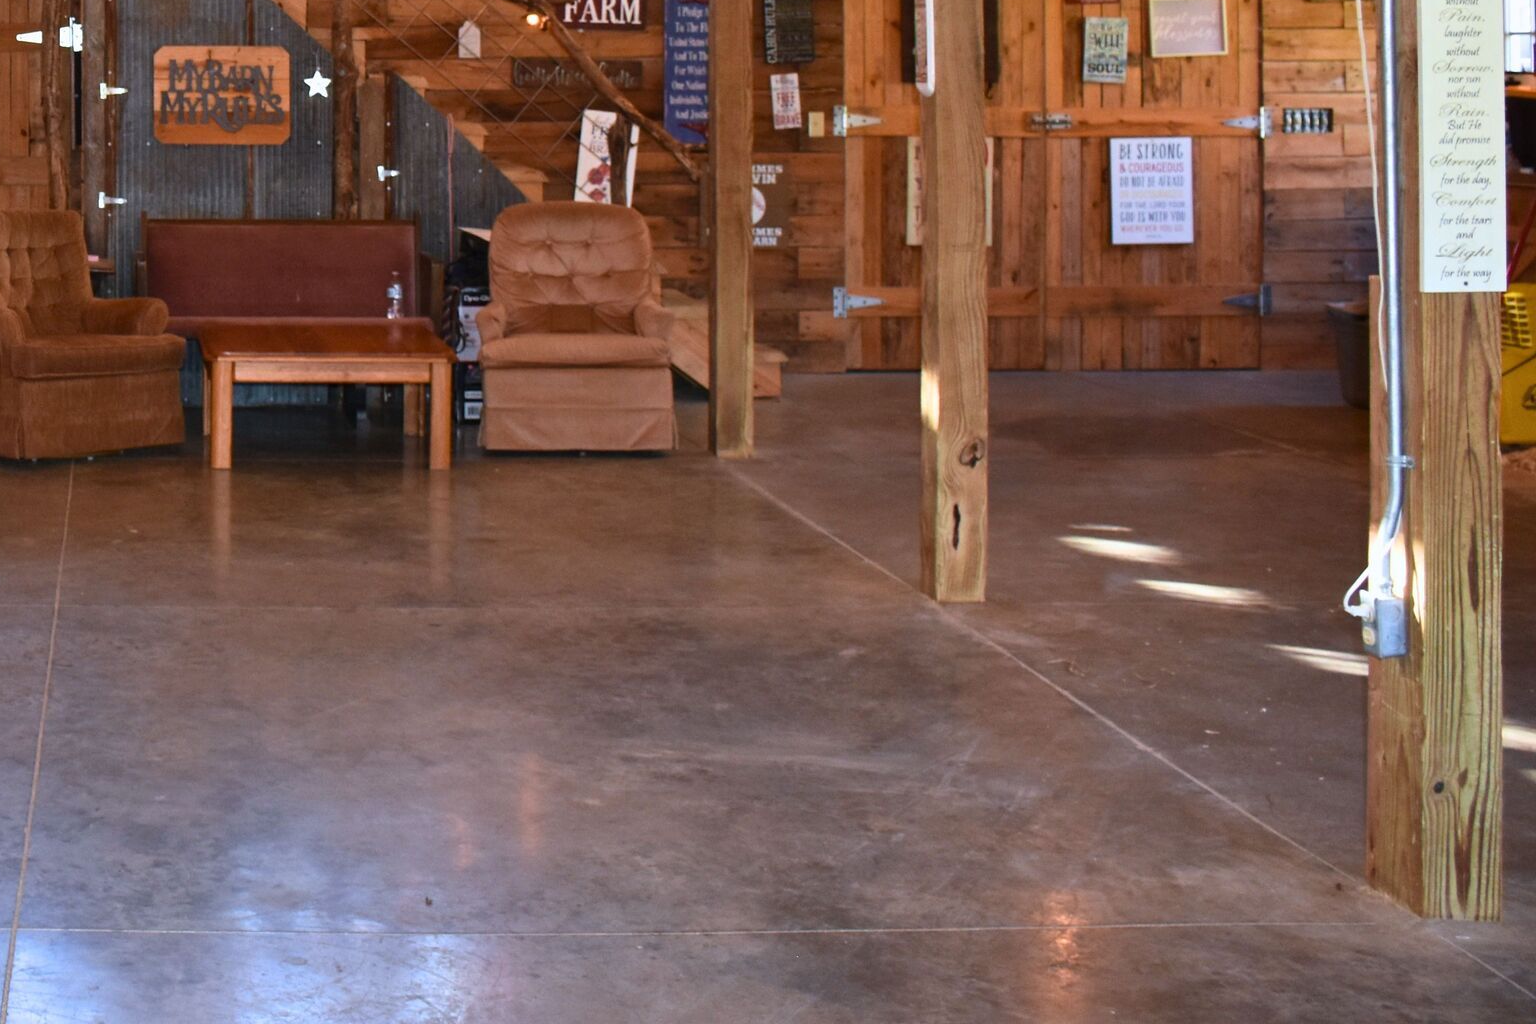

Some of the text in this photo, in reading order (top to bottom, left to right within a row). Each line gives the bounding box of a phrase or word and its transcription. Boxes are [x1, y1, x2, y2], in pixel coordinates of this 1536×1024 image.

[1438, 8, 1486, 23] Pain.
[1444, 25, 1483, 43] laughter
[1446, 44, 1481, 57] without
[1087, 62, 1124, 74] SOUL
[1448, 76, 1463, 85] nor
[1446, 86, 1481, 99] without
[1439, 103, 1490, 118] Rain.
[1448, 119, 1482, 131] But He
[1439, 132, 1491, 150] did promise
[1119, 142, 1184, 160] BE STRONG
[1128, 162, 1184, 174] COURAGEOUS
[1429, 152, 1497, 171] Strength
[1131, 176, 1145, 188] NOT
[1158, 175, 1184, 187] AFRAID
[1440, 172, 1454, 191] for
[1456, 172, 1470, 185] the
[1432, 191, 1497, 209] Comfort
[1439, 213, 1493, 228] for the tears
[1456, 227, 1475, 240] and
[1435, 242, 1494, 262] Light
[1440, 265, 1492, 283] for the way
